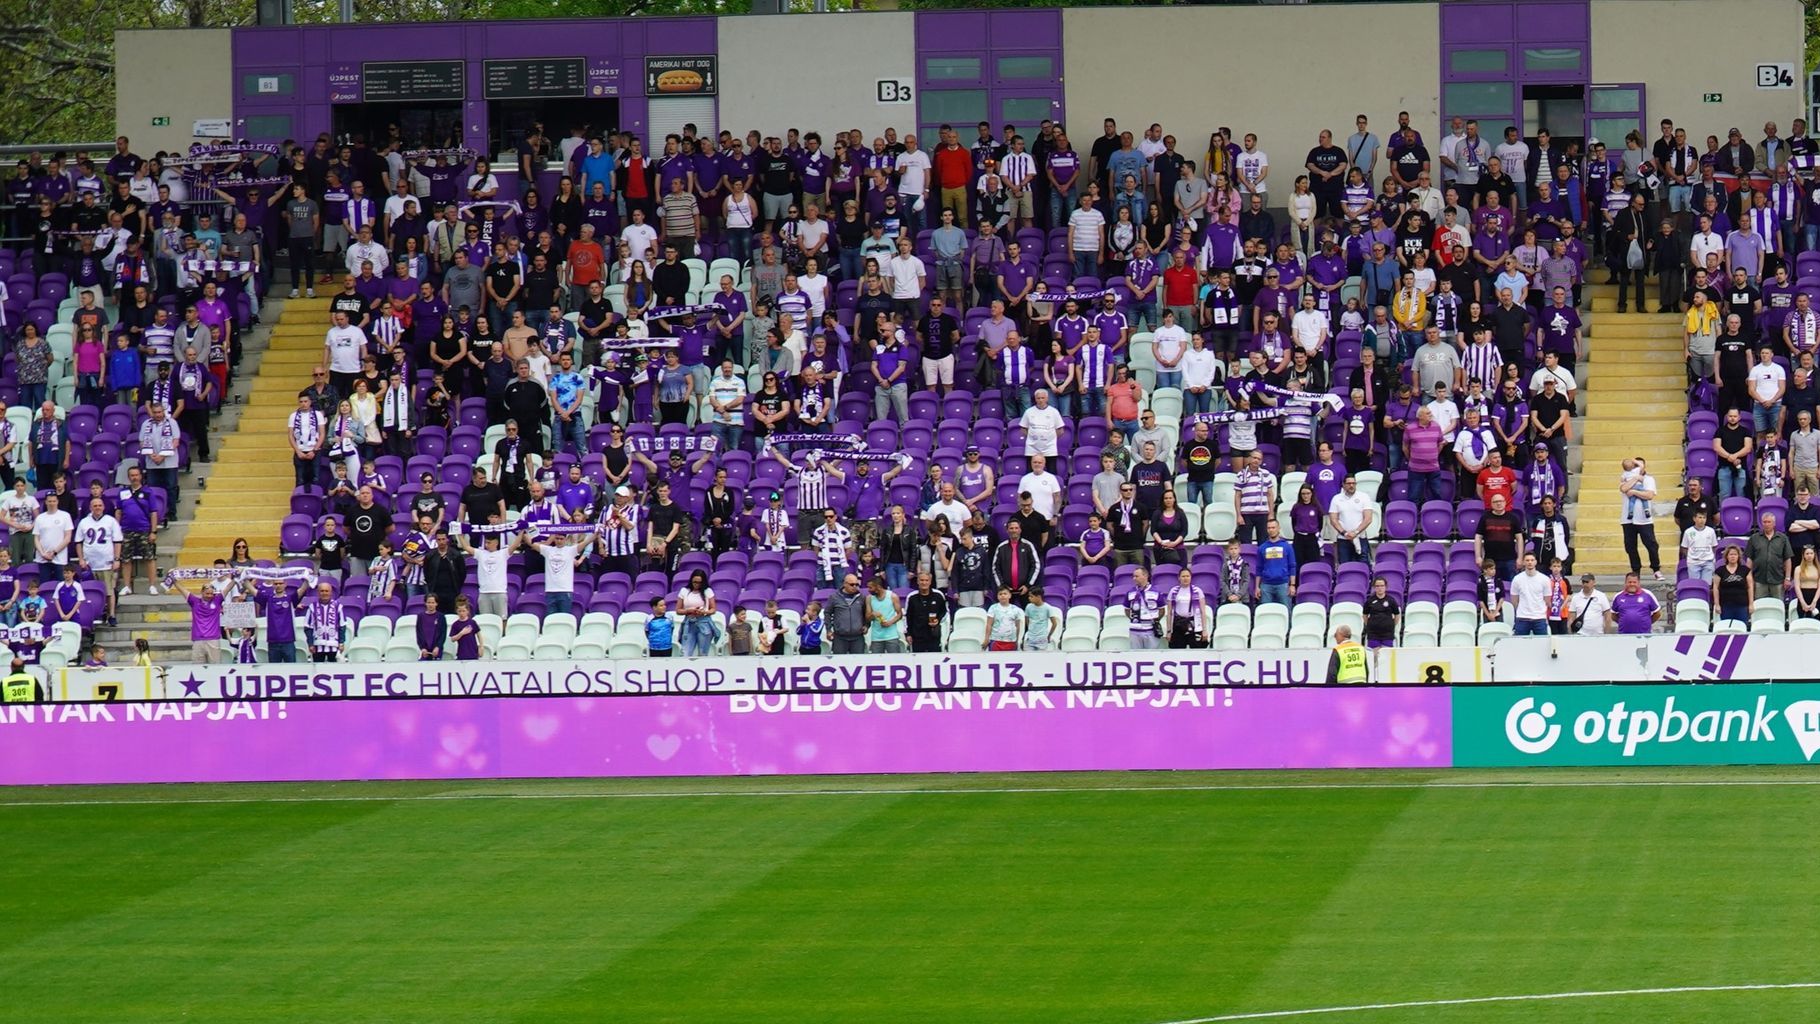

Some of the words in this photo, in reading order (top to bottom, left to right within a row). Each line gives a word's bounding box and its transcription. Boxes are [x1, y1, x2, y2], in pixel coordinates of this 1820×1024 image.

[1758, 66, 1793, 87] B4
[878, 81, 911, 101] B3
[87, 527, 106, 545] 92
[220, 669, 355, 698] ÚJPEST
[365, 674, 408, 697] FC
[619, 669, 725, 694] SHOP
[757, 665, 925, 693] MEGYERI
[936, 657, 982, 690] ÚT
[991, 663, 1033, 689] 13.
[1065, 660, 1309, 689] UJPESTFC.HU
[12, 688, 27, 697] 309
[98, 685, 118, 701] 7
[1573, 695, 1780, 757] otpbank
